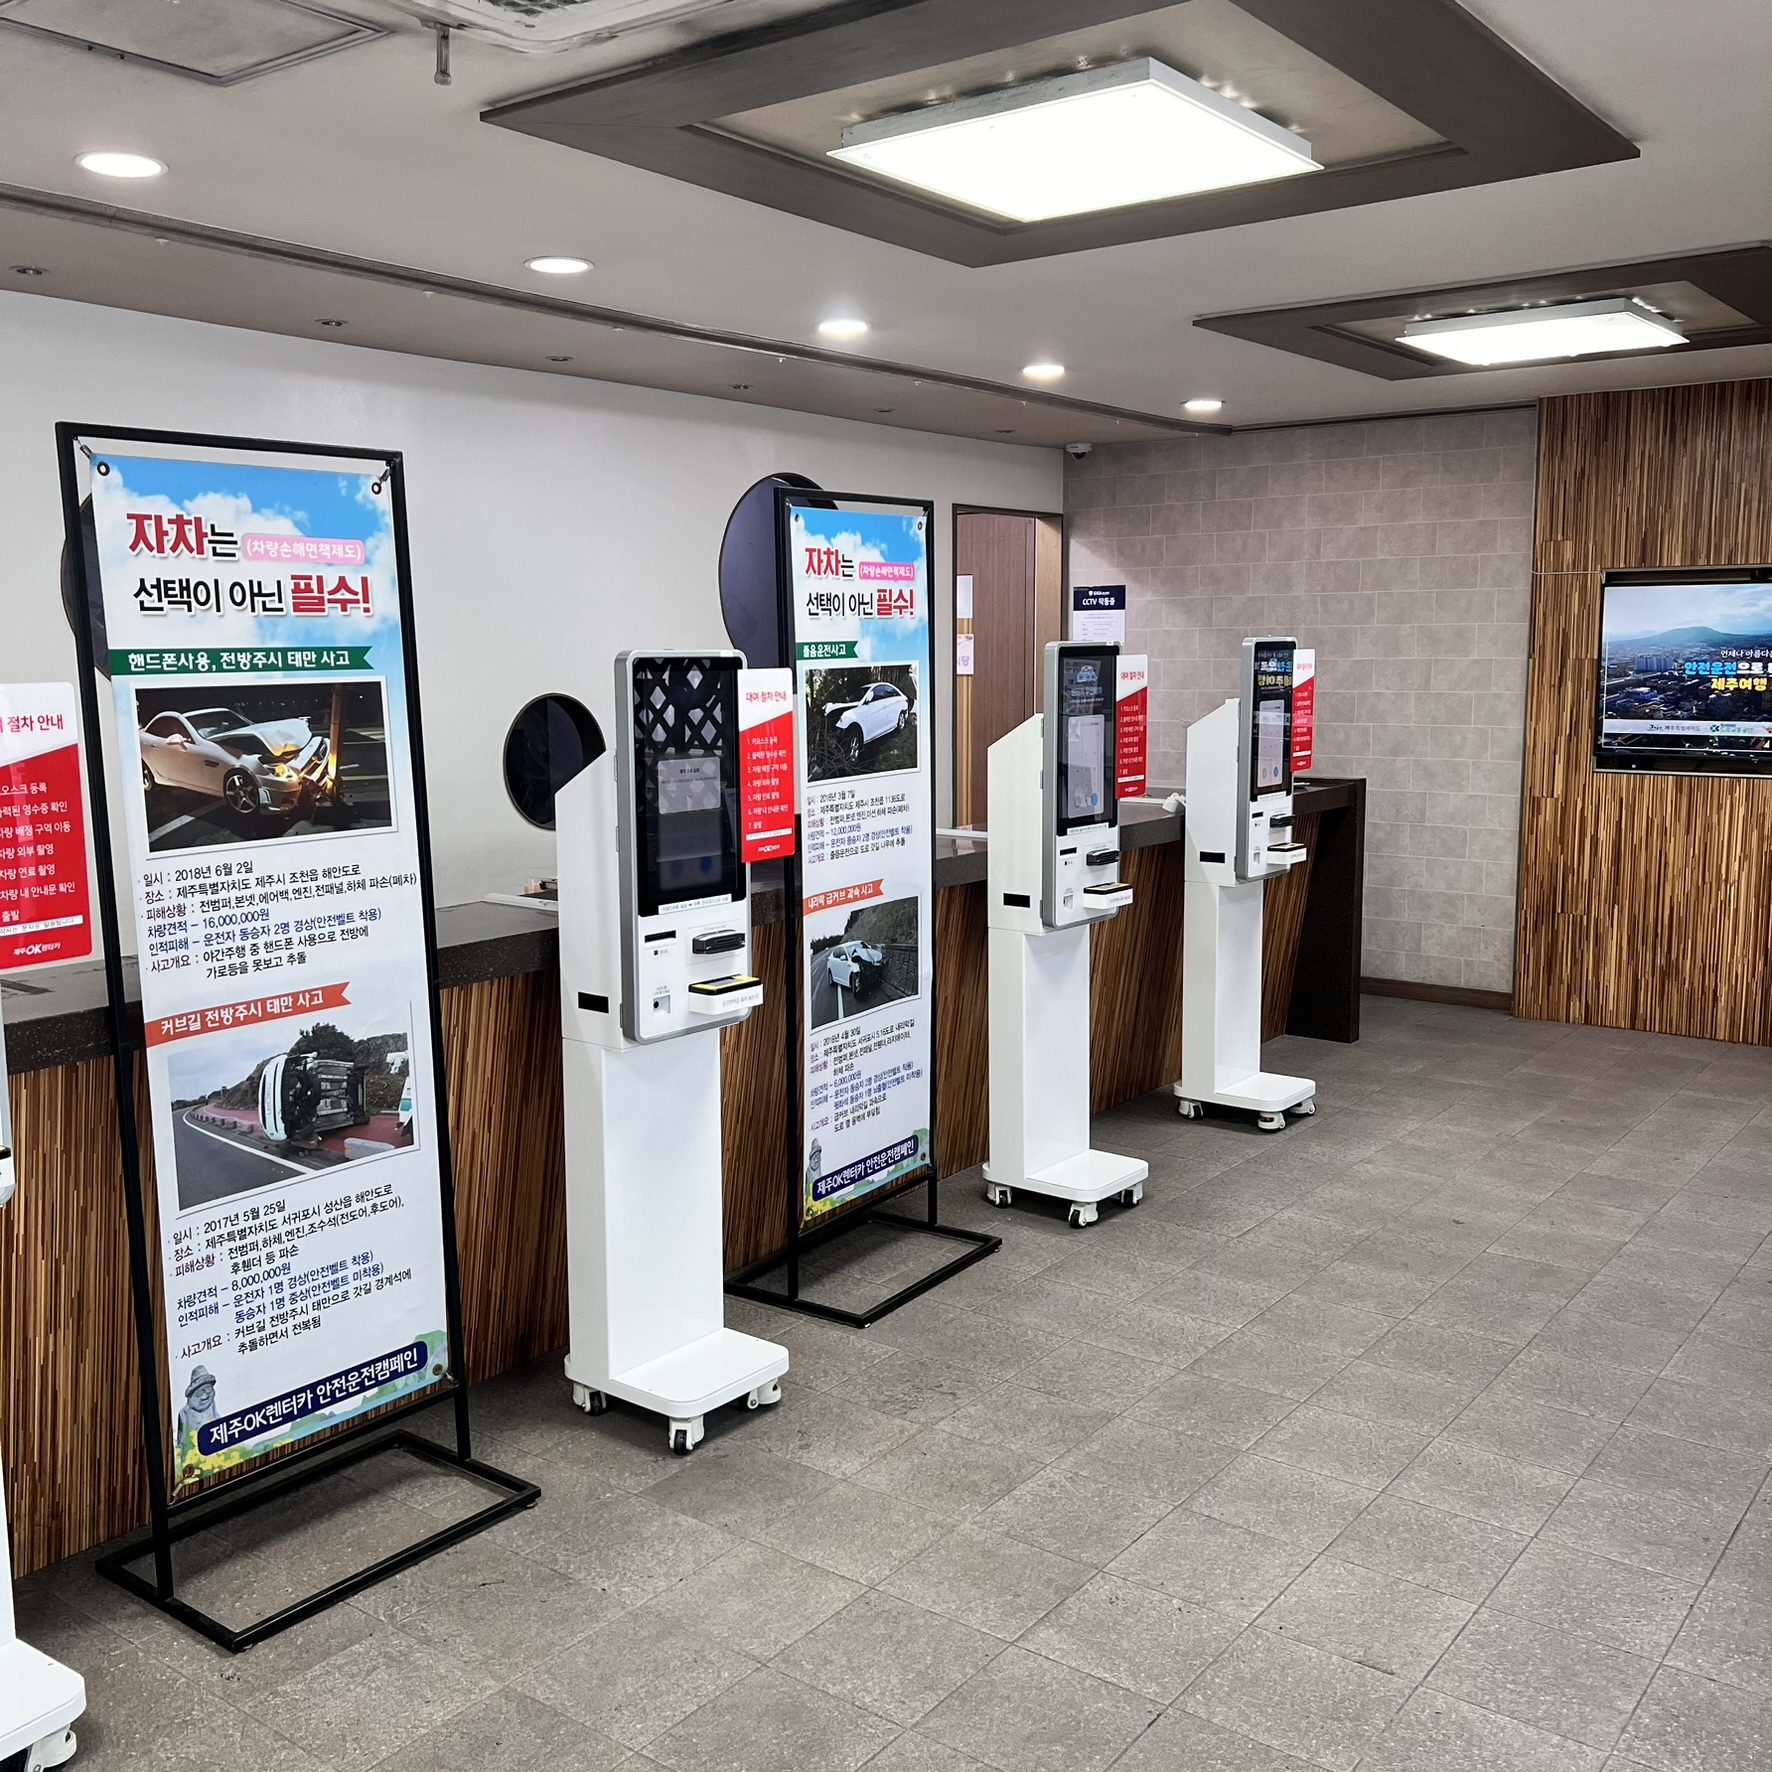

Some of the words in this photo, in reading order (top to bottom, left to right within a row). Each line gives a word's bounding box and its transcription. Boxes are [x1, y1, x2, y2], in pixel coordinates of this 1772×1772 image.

[127, 512, 239, 559] 자차는
[246, 538, 362, 561] (차량손해면책제도)
[805, 548, 854, 578] 자차는
[860, 564, 913, 578] (차량손해면책제도)
[134, 576, 222, 613] 선택이
[230, 579, 284, 613] 아닌
[291, 575, 371, 614] 필수!
[806, 592, 845, 616] 선택이
[848, 592, 873, 616] 아닌
[876, 589, 913, 616] 필수!
[1082, 598, 1098, 606] CCTV
[128, 651, 216, 672] 핸드폰사용,
[220, 652, 282, 670] 전방주시
[288, 651, 318, 669] 태만
[321, 650, 350, 667] 사고
[1684, 661, 1764, 675] 안전운전으로
[1711, 677, 1768, 691] 제주여행
[7, 714, 34, 732] 절차
[37, 714, 64, 731] 안내
[30, 782, 48, 794] 등록
[22, 802, 48, 816] 영수증
[51, 801, 68, 813] 확인
[16, 825, 34, 838] 배정
[35, 823, 52, 835] 구역
[54, 820, 71, 834] 이동
[18, 846, 34, 858] 외부
[36, 843, 54, 856] 촬영
[18, 866, 36, 878] 연료
[38, 864, 56, 876] 촬영
[175, 865, 211, 882] 2018년
[215, 863, 233, 877] 6월
[236, 860, 253, 874] 2일
[177, 879, 251, 899] 제주특별자치도
[255, 873, 286, 888] 제주시
[289, 868, 318, 884] 조천읍
[322, 864, 361, 879] 해안도로
[0, 889, 18, 901] 차량
[20, 888, 30, 899] 내
[31, 884, 58, 898] 안내문
[58, 881, 76, 894] 확인
[861, 884, 873, 894] 사고
[2, 910, 20, 922] 출발
[148, 921, 187, 939] 차량견적
[203, 908, 270, 929] 16,000,000원
[149, 937, 189, 957] 인적피해
[203, 931, 236, 947] 운전자
[239, 924, 271, 942] 동승자
[274, 922, 290, 936] 2명
[294, 912, 356, 933] 경상(안전벨트
[358, 907, 382, 921] 착용)
[203, 945, 246, 963] 야간주행
[251, 943, 260, 956] 중
[264, 937, 294, 954] 핸드폰
[298, 931, 336, 948] 사용으로
[340, 925, 369, 942] 전방에
[206, 961, 248, 979] 가로등을
[252, 956, 284, 972] 못보고
[287, 952, 306, 966] 추돌
[161, 1013, 202, 1036] 커브길
[205, 1002, 262, 1028] 전방주시
[266, 995, 293, 1014] 태만
[297, 989, 324, 1008] 사고
[204, 1212, 240, 1234] 2017년
[243, 1207, 260, 1222] 5월
[264, 1199, 286, 1215] 25일
[205, 1218, 278, 1250] 제주특별자치도
[282, 1204, 320, 1227] 서귀포시
[324, 1196, 352, 1214] 성산읍
[355, 1184, 393, 1204] 해안도로
[265, 1251, 276, 1264] 등
[279, 1243, 299, 1259] 파손
[177, 1285, 218, 1311] 차량견적
[231, 1262, 291, 1291] 8,000,000원
[178, 1302, 220, 1328] 인적피해
[233, 1287, 265, 1309] 운전자
[268, 1280, 284, 1295] 1명
[287, 1259, 349, 1290] 경상(안전벨트
[351, 1250, 374, 1267] 착용)
[234, 1303, 267, 1324] 동승자
[270, 1295, 286, 1311] 1명
[288, 1274, 350, 1306] 중상(안전벨트
[352, 1262, 384, 1282] 미착용)
[234, 1318, 266, 1339] 커브길
[268, 1306, 310, 1328] 전방주시
[312, 1290, 351, 1312] 태만으로
[352, 1283, 372, 1299] 갓길
[374, 1268, 412, 1291] 경계석에
[238, 1326, 289, 1355] 추돌하면서
[292, 1315, 322, 1337] 전복됨
[210, 1389, 313, 1444] 제주OK렌터카
[316, 1347, 418, 1403] 안전운전캠페인
